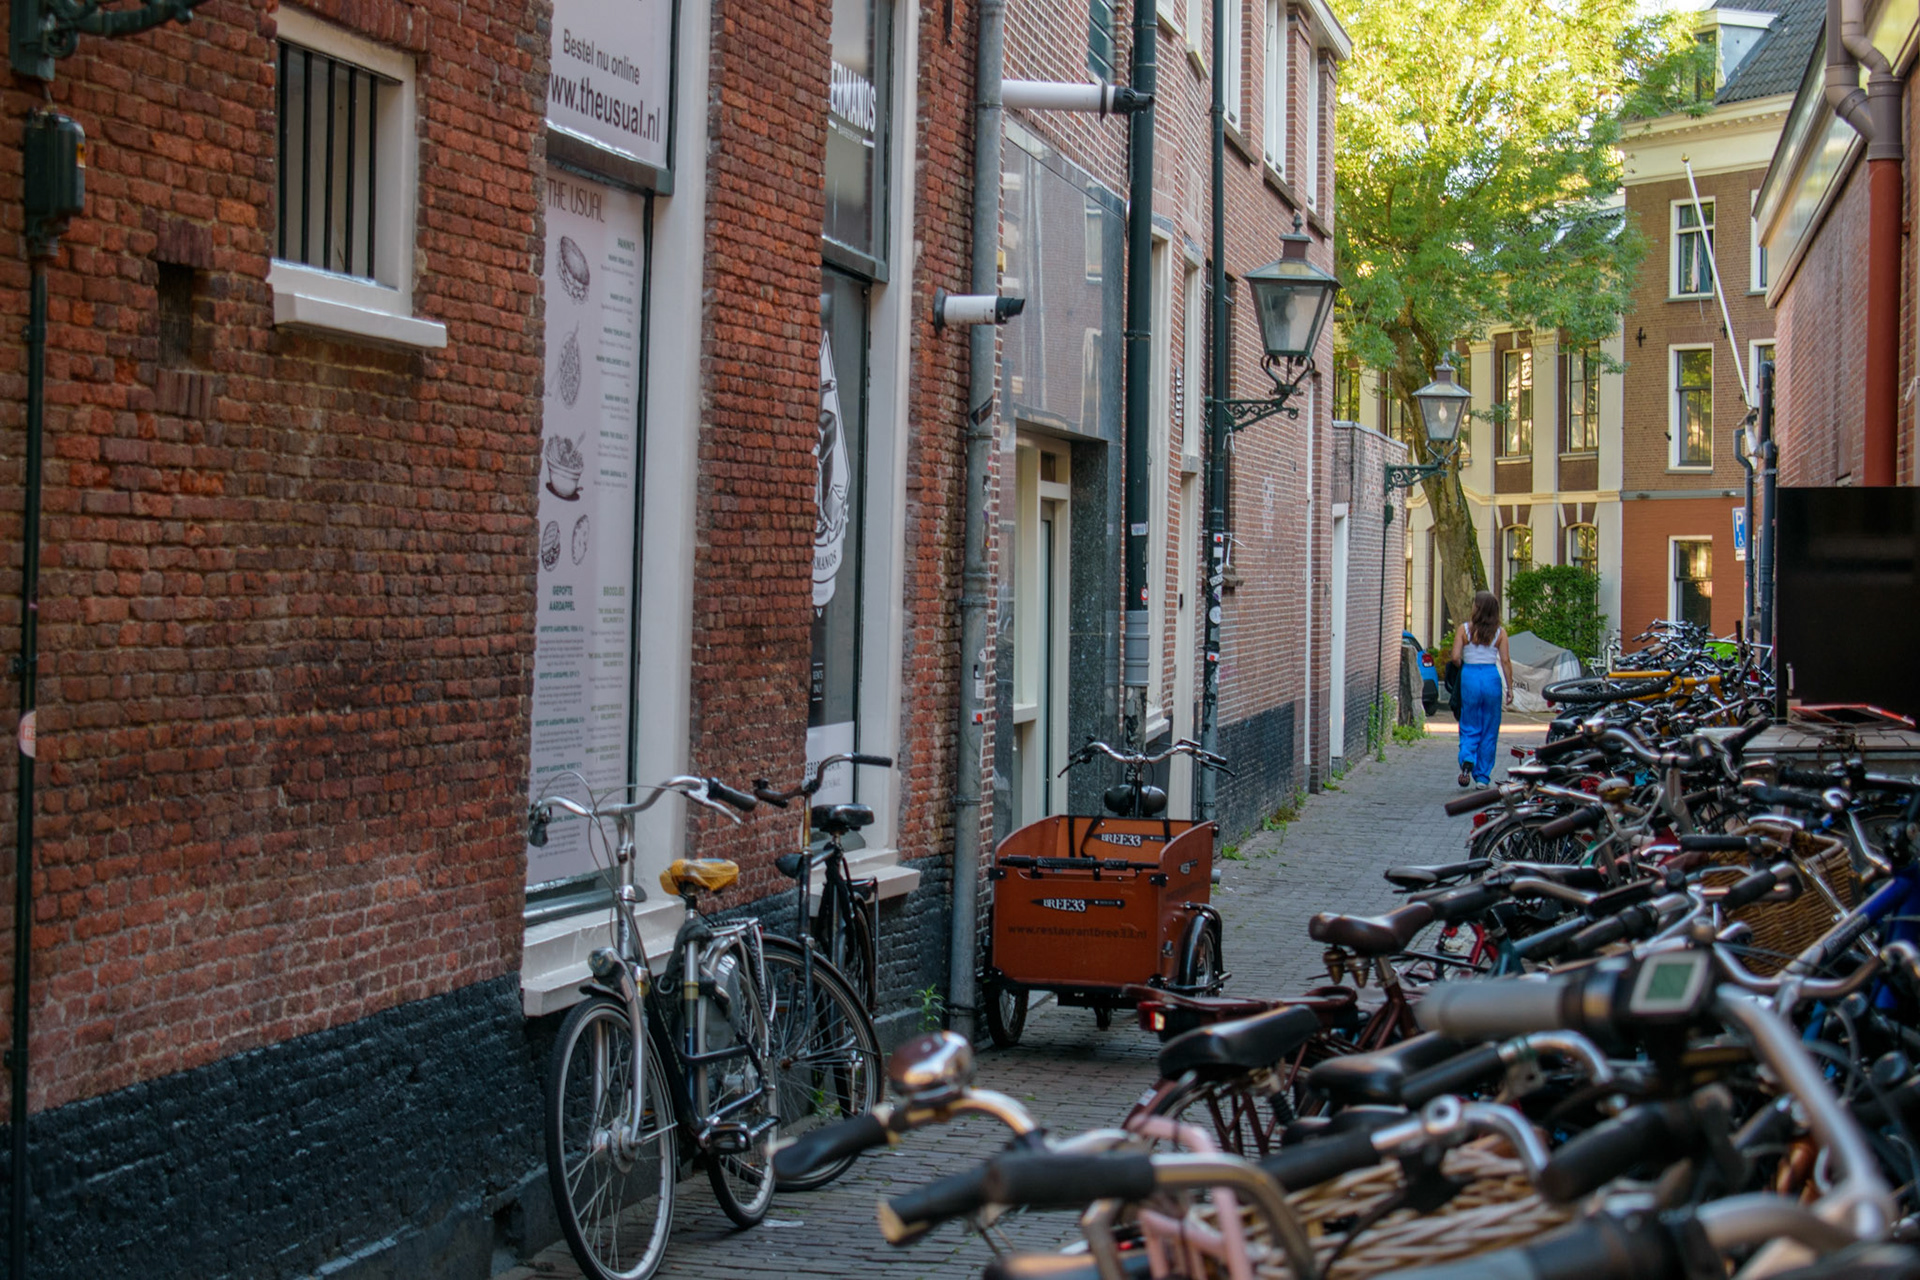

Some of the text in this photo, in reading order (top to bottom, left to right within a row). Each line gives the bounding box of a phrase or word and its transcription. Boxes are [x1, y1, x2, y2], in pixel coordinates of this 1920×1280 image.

[563, 28, 640, 86] Bestel nu online
[548, 72, 660, 143] ww.theusual.nl
[829, 60, 877, 133] ERMANOS
[546, 177, 606, 224] THE USUAL
[1735, 511, 1744, 533] P
[1101, 833, 1142, 848] BREE33
[1043, 898, 1087, 913] BREE33
